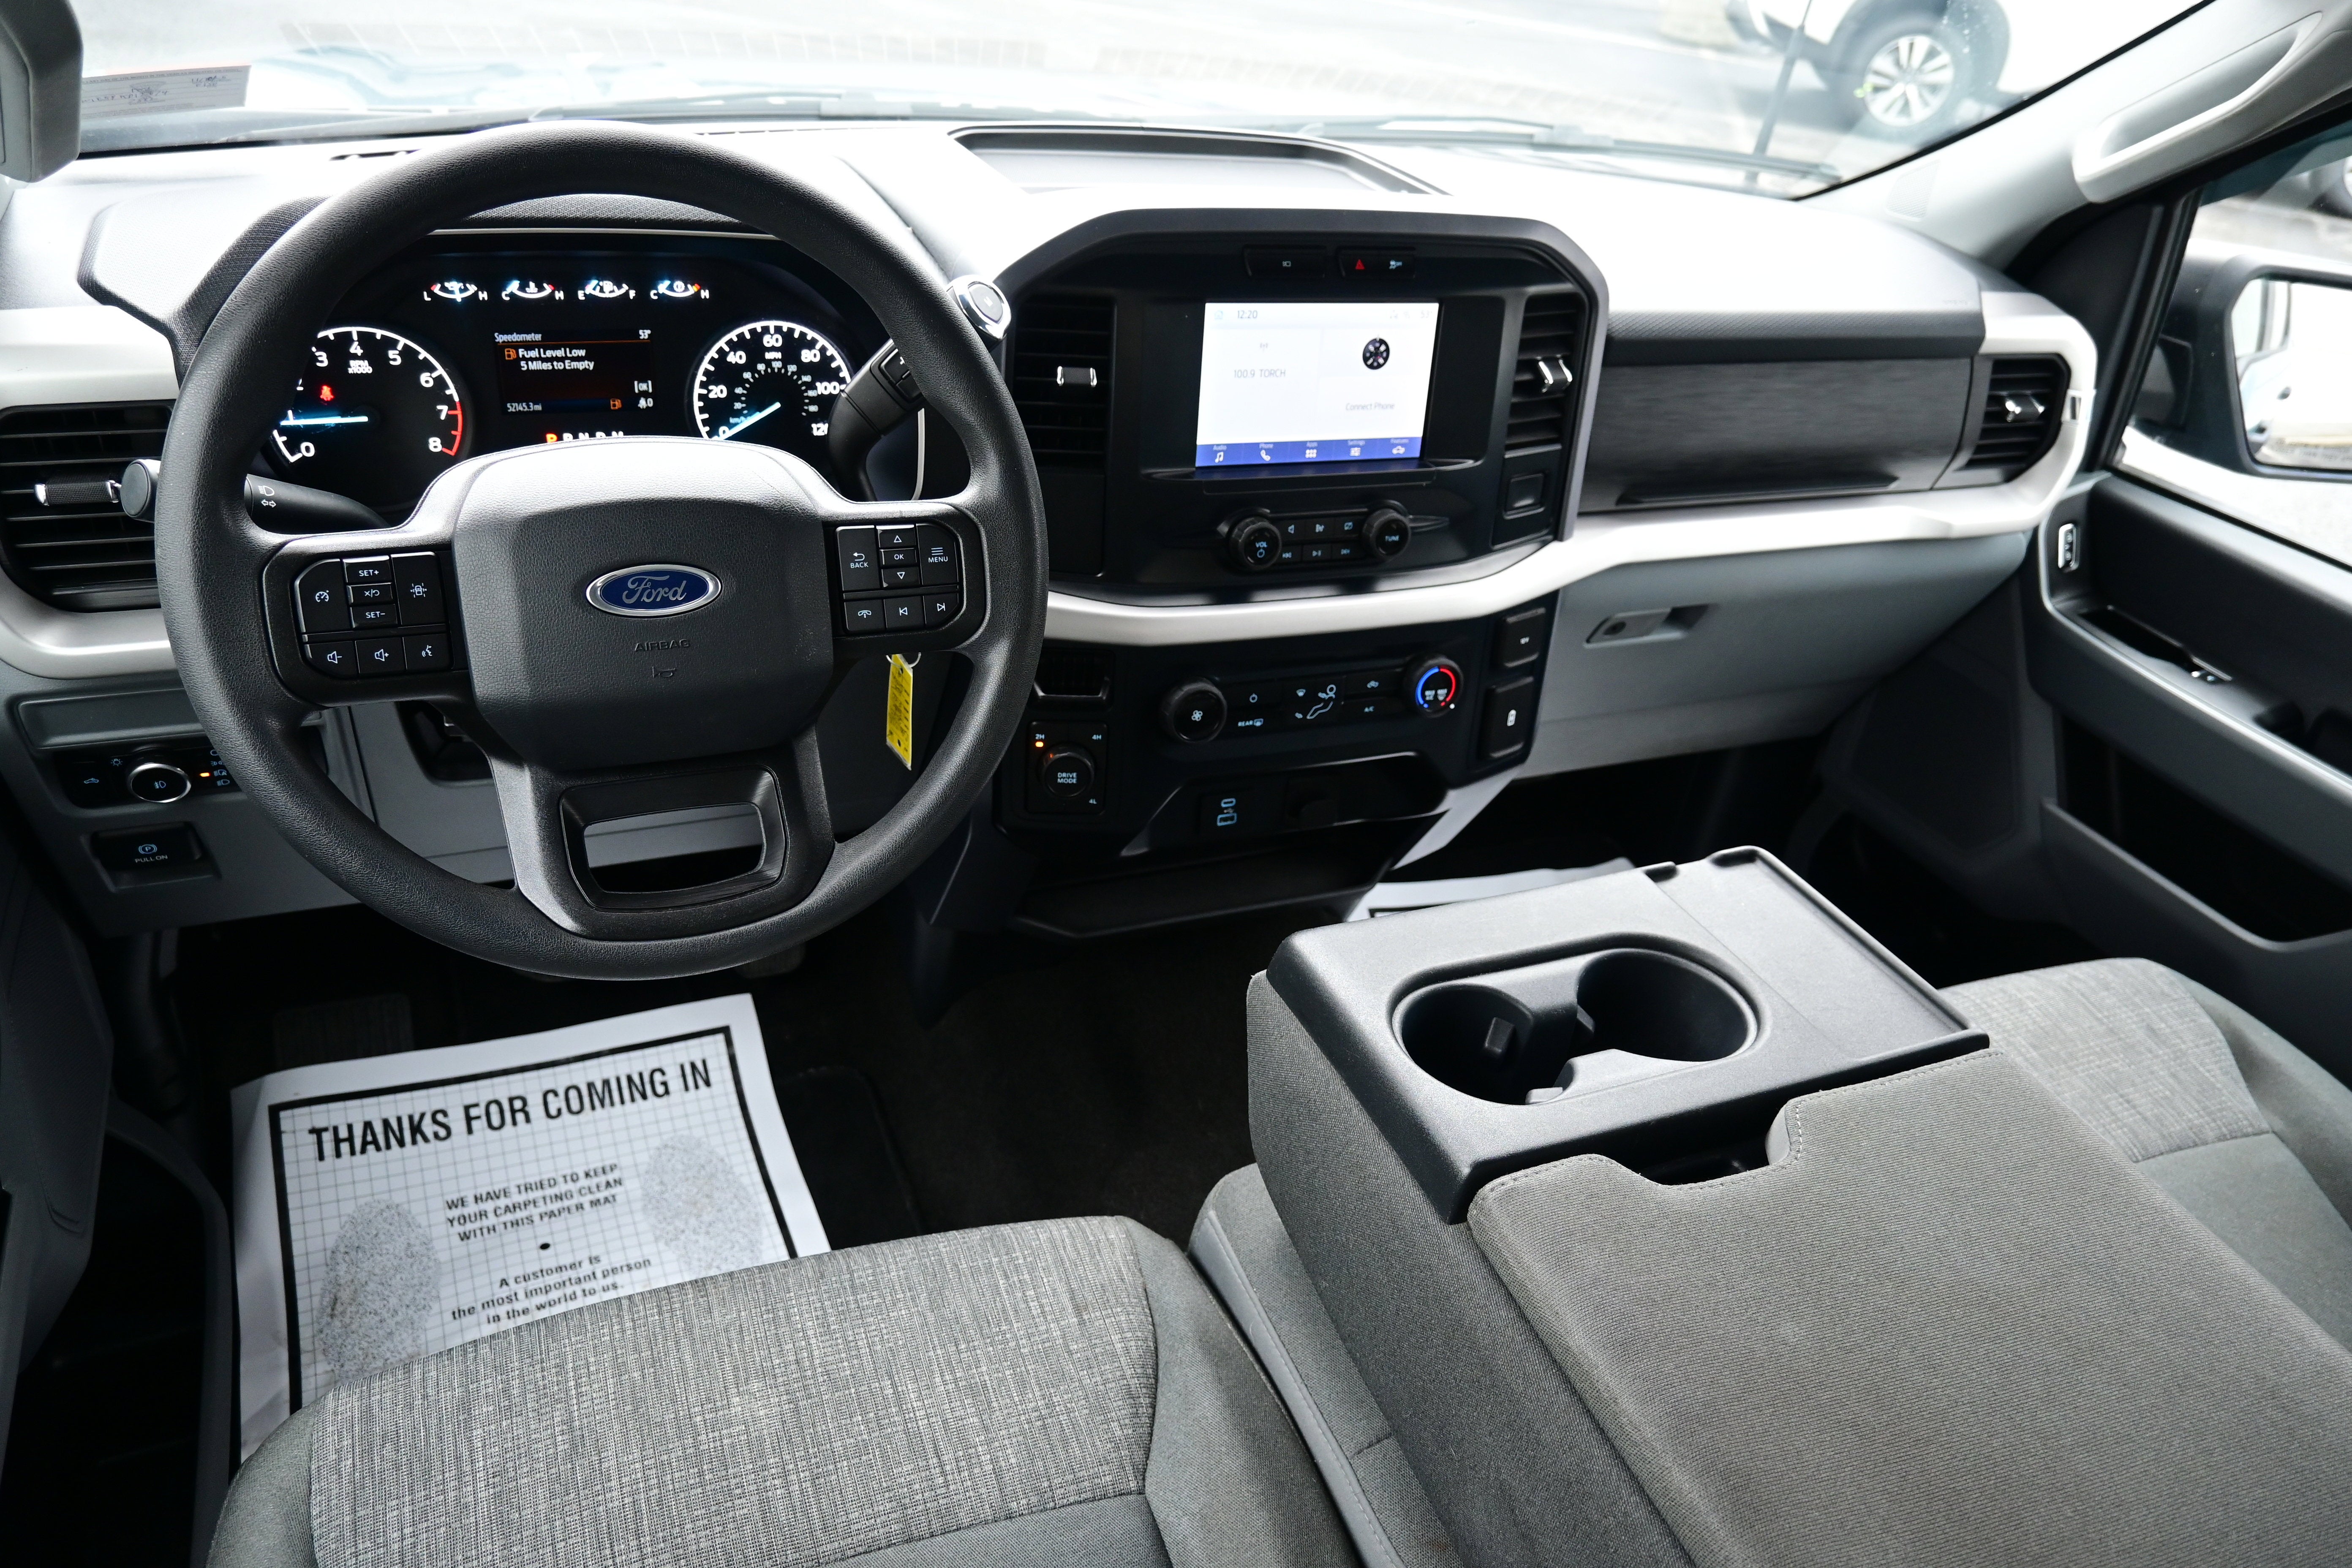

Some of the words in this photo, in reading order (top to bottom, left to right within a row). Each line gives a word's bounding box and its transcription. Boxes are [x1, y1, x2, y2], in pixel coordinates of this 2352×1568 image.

[423, 291, 431, 301] L
[478, 291, 488, 301] H
[501, 291, 510, 301] C
[555, 290, 564, 300] H
[577, 289, 586, 300] E
[629, 289, 636, 299] F
[650, 289, 659, 299] C
[700, 289, 710, 299] H
[1237, 310, 1258, 319] 12:20
[494, 332, 542, 343] Speedometer
[763, 334, 783, 347] 60
[349, 341, 363, 356] 4
[518, 348, 539, 358] Fuel
[540, 347, 566, 358] Level
[566, 348, 586, 357] Low
[765, 351, 782, 359] MPH
[315, 351, 329, 367] 3
[388, 350, 402, 365] 5
[726, 351, 747, 364] 40
[801, 349, 821, 362] 80
[349, 360, 368, 368] RPM
[520, 361, 528, 370] 5
[528, 360, 553, 370] Miles
[553, 361, 564, 370] to
[565, 359, 594, 370] Empty
[1234, 369, 1255, 378] 100.9
[1259, 369, 1286, 378] TORCH
[420, 373, 434, 388] 6
[708, 385, 727, 398] 20
[815, 381, 841, 395] 100
[436, 405, 449, 420] 7
[1346, 402, 1372, 411] Connect
[1374, 402, 1395, 410] Phone
[300, 441, 315, 457] 0
[428, 437, 442, 452] 8
[622, 575, 687, 604] Ford
[634, 639, 691, 652] AIRBAG
[308, 1108, 452, 1162] THANKS
[464, 1095, 531, 1135] FOR
[542, 1067, 670, 1120] COMING
[680, 1058, 711, 1092] IN
[446, 1198, 469, 1210] WE
[474, 1189, 511, 1206] HAVE
[516, 1177, 557, 1195] TRIED
[562, 1172, 579, 1184] TO
[585, 1163, 617, 1179] KEEP
[446, 1209, 489, 1227] YOUR
[493, 1189, 574, 1217] CARPETING
[579, 1177, 623, 1196] CLEAN
[458, 1225, 497, 1241] WITH
[503, 1215, 534, 1231] THIS
[539, 1204, 585, 1222] PAPER
[590, 1194, 618, 1209] MAT
[498, 1278, 509, 1288] A
[514, 1260, 583, 1285] customer
[452, 1306, 476, 1320] the
[481, 1291, 519, 1309] most
[524, 1271, 597, 1299] important
[602, 1258, 652, 1280] person
[487, 1314, 501, 1324] in
[506, 1306, 530, 1320] the
[535, 1292, 578, 1311] world
[583, 1288, 596, 1298] to
